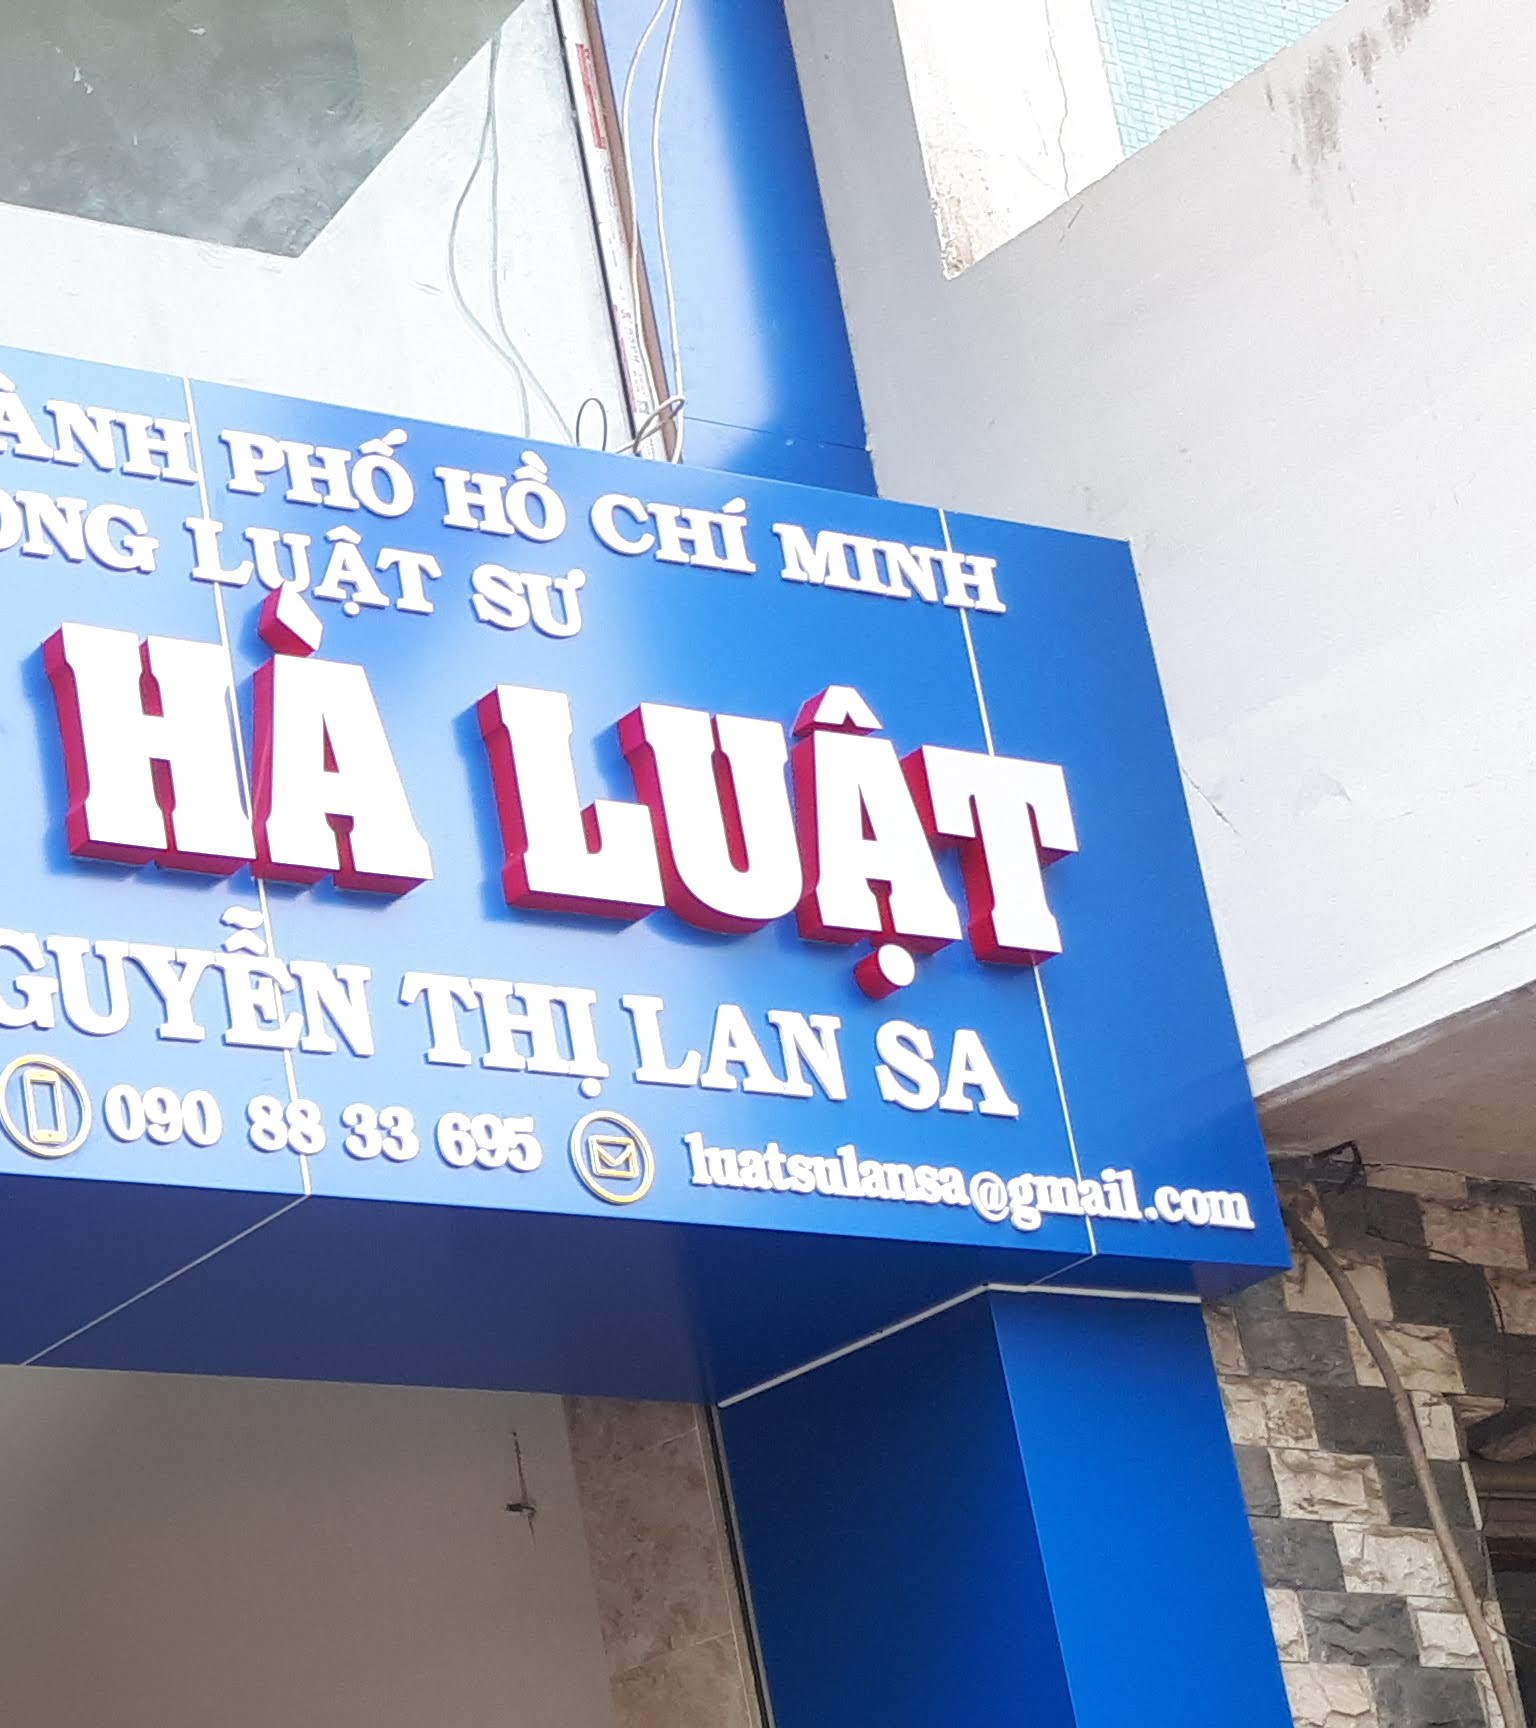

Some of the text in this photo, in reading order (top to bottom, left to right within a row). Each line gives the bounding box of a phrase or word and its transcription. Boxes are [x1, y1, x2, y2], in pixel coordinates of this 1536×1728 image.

[184, 519, 441, 617] LUẬT
[470, 566, 586, 639] SƯ
[220, 428, 415, 520] PHỐ
[435, 450, 566, 544] HỒ
[590, 497, 756, 577] CHÍ
[773, 522, 1006, 616] MINH
[41, 586, 434, 898] HÀ
[477, 685, 1078, 1000] LUẬT
[400, 970, 609, 1099] THỊ
[620, 992, 848, 1102] LAN
[874, 1019, 1020, 1119] SA
[103, 1084, 536, 1173] 090 88 33 695
[685, 1131, 1256, 1230] luatsulansa@gmail.com
